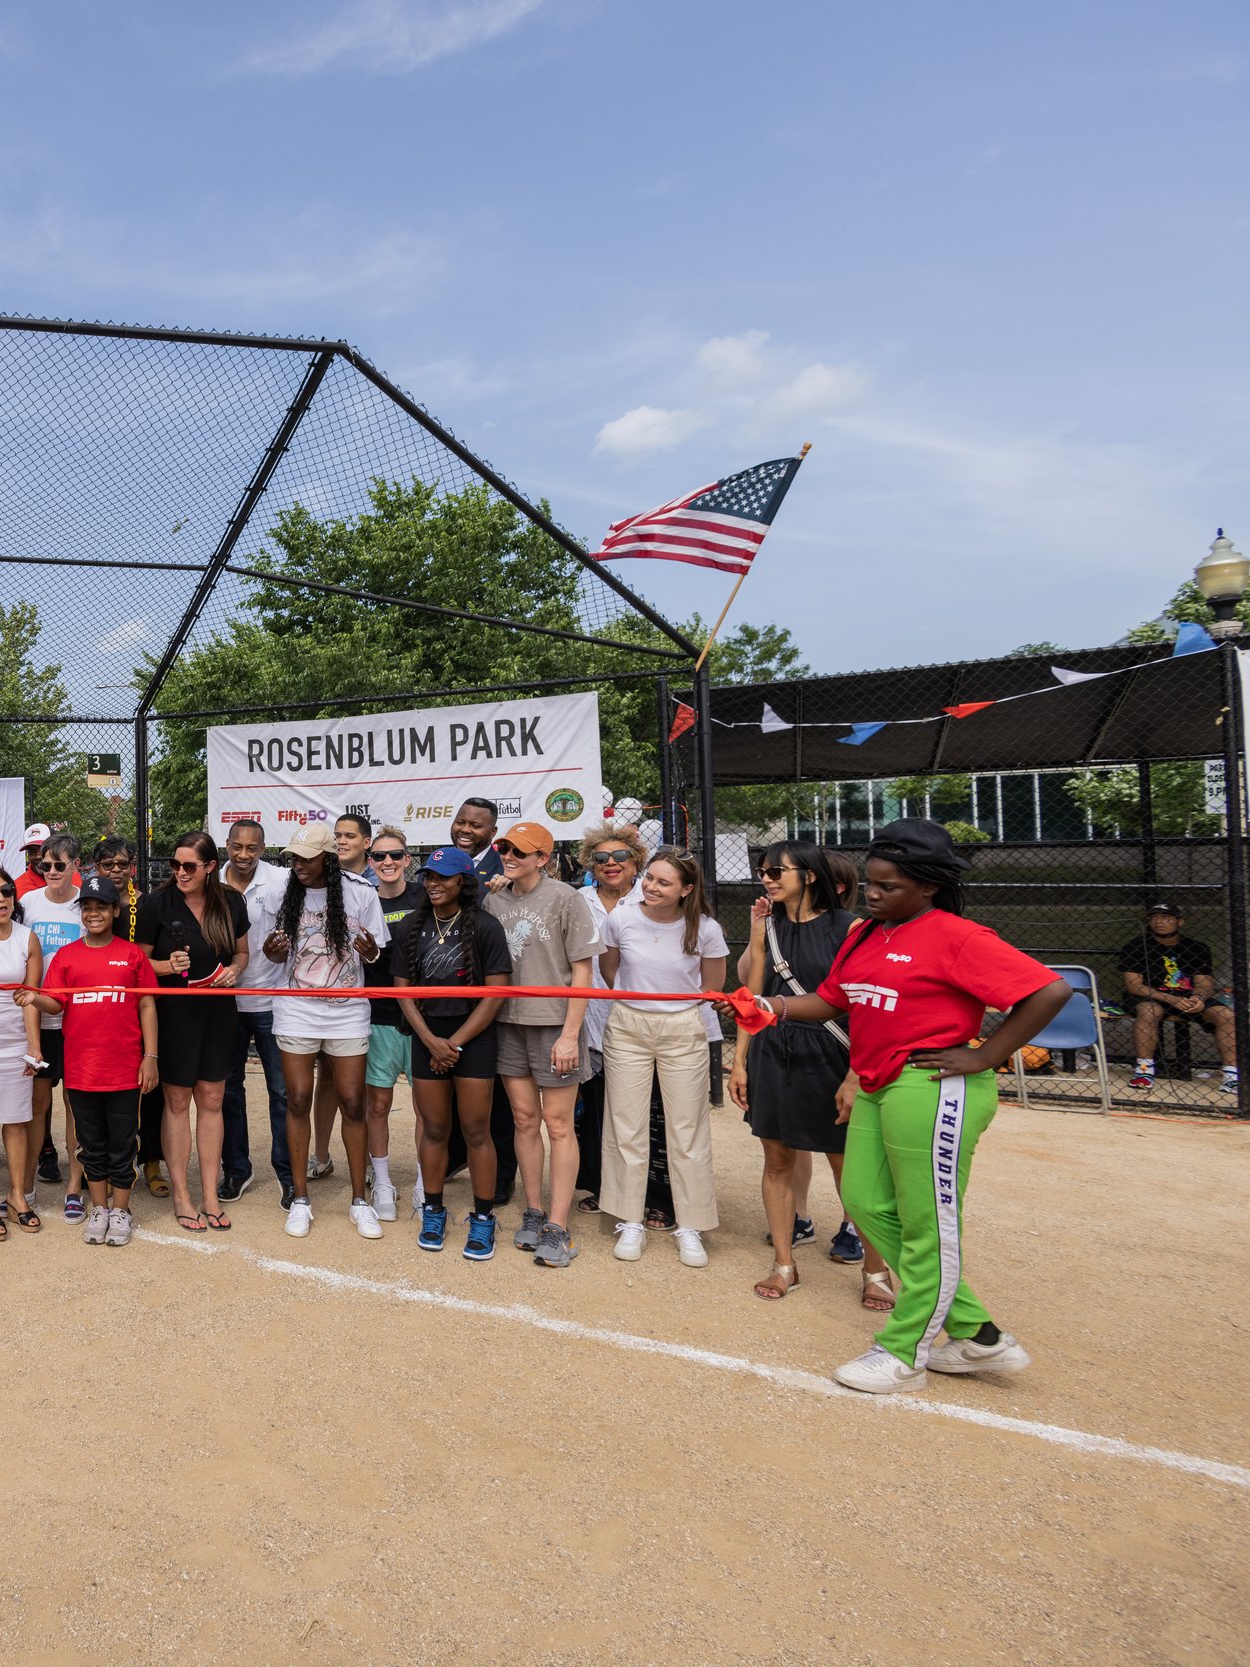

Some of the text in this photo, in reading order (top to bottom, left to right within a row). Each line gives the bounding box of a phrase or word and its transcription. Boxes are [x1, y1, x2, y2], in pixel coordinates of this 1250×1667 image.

[247, 715, 545, 773] ROSENBLUM PARK
[92, 755, 101, 771] 3
[415, 806, 454, 819] RISE
[510, 909, 518, 919] IN
[520, 909, 551, 942] PURPOSE
[937, 1099, 959, 1205] THUNDER
